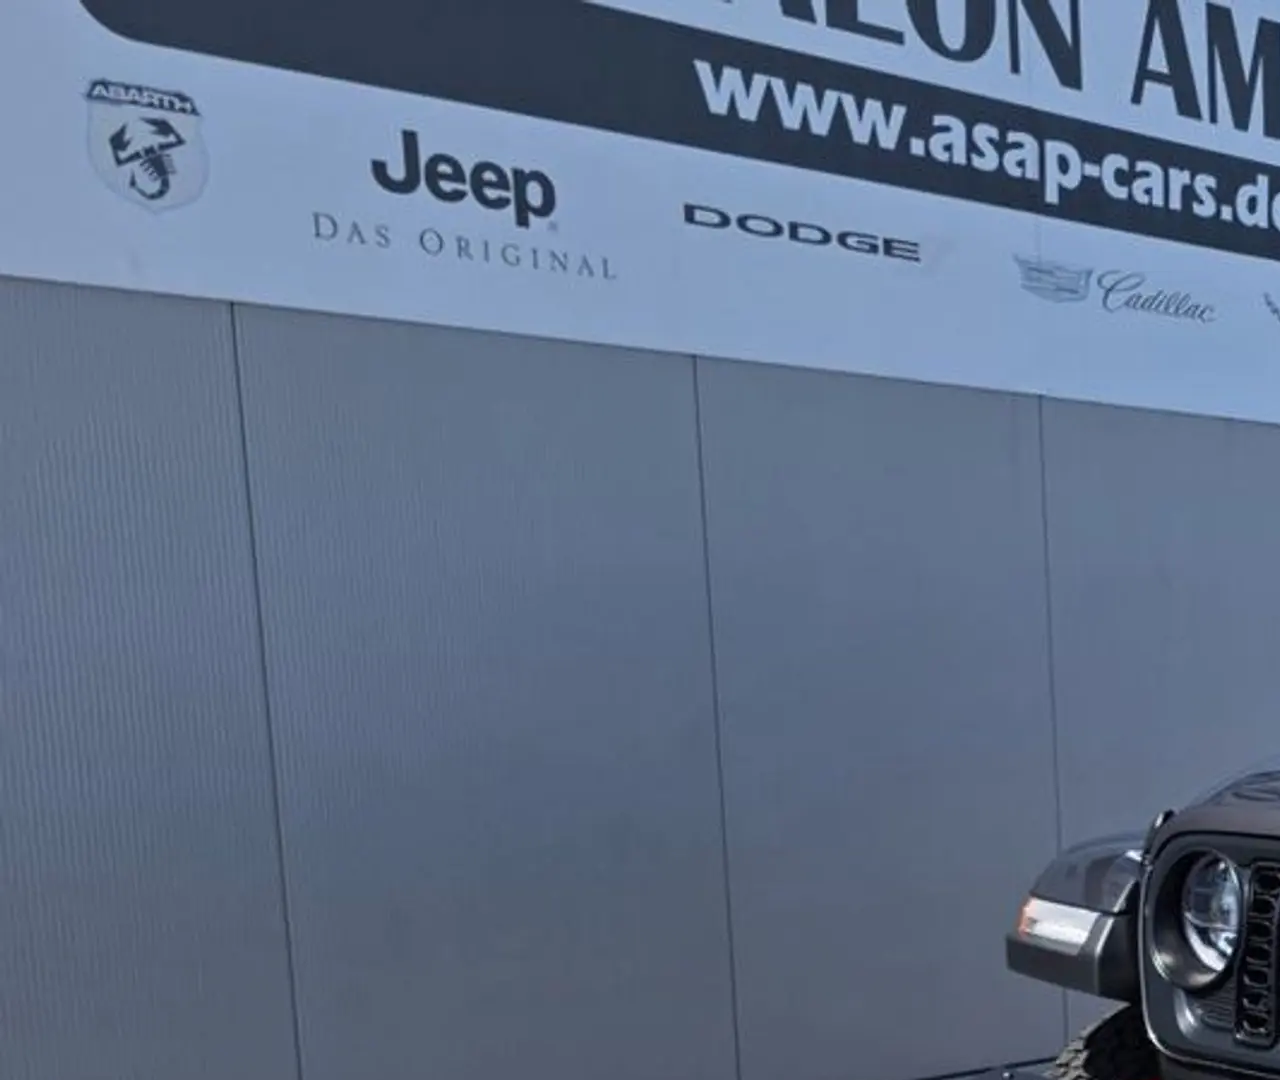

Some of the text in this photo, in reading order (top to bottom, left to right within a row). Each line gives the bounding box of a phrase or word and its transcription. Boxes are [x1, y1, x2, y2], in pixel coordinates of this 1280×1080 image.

[91, 82, 195, 115] ABARTH
[371, 129, 556, 229] Jeep
[312, 211, 618, 280] DAS ORIGINAL
[683, 203, 921, 263] DODGE
[1097, 269, 1217, 323] Cadillac
